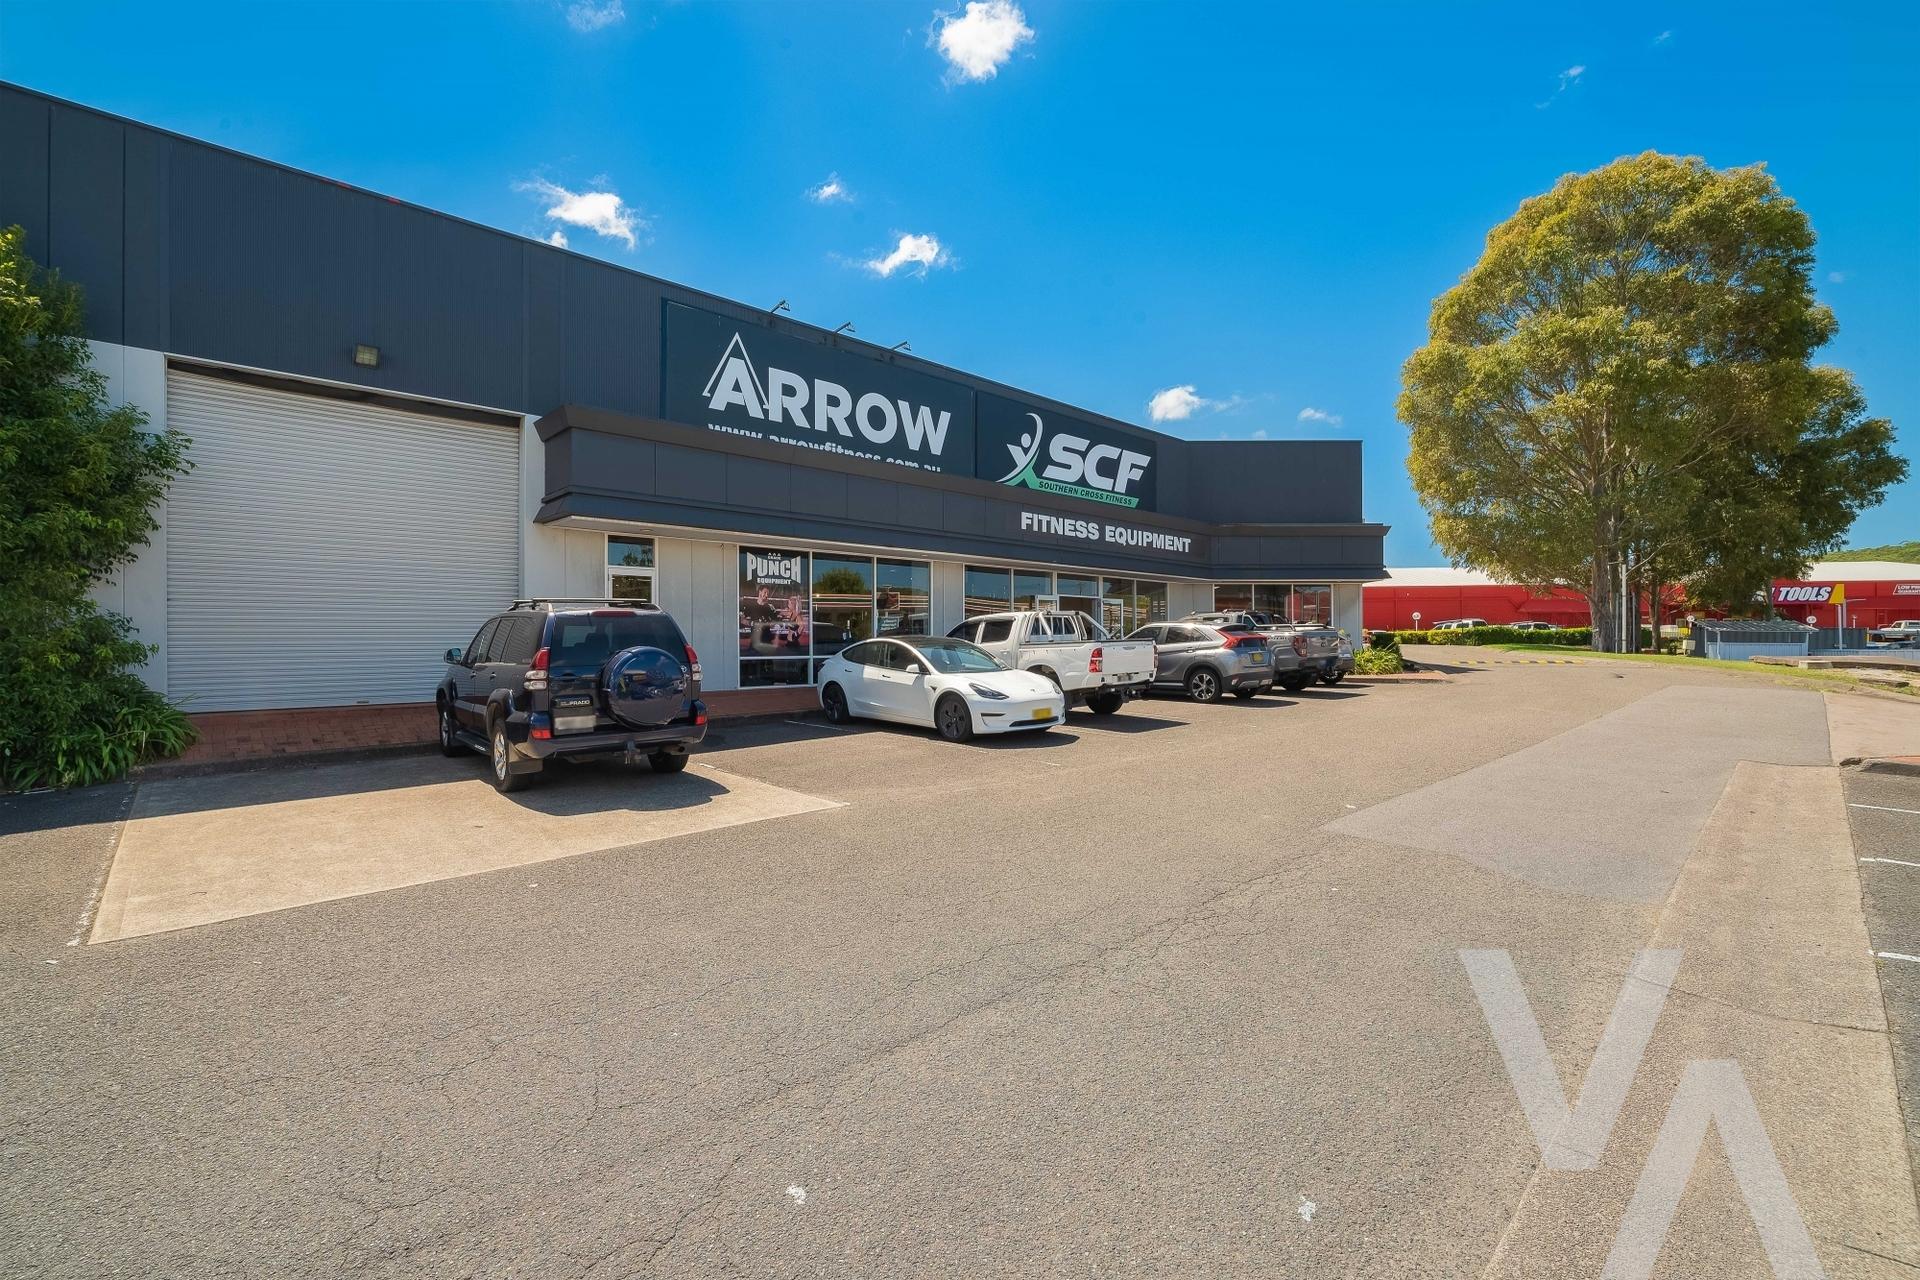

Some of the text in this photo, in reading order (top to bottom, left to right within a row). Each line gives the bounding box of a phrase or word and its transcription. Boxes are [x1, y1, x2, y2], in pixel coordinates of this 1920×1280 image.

[706, 355, 952, 456] ARROW
[1042, 433, 1151, 494] SCF
[1039, 481, 1132, 506] SOUTHERN CROSS FITNESS
[1021, 511, 1192, 553] FITNESS EQUIPMENT
[746, 551, 801, 584] PUNCH
[1777, 586, 1832, 602] TOOLS
